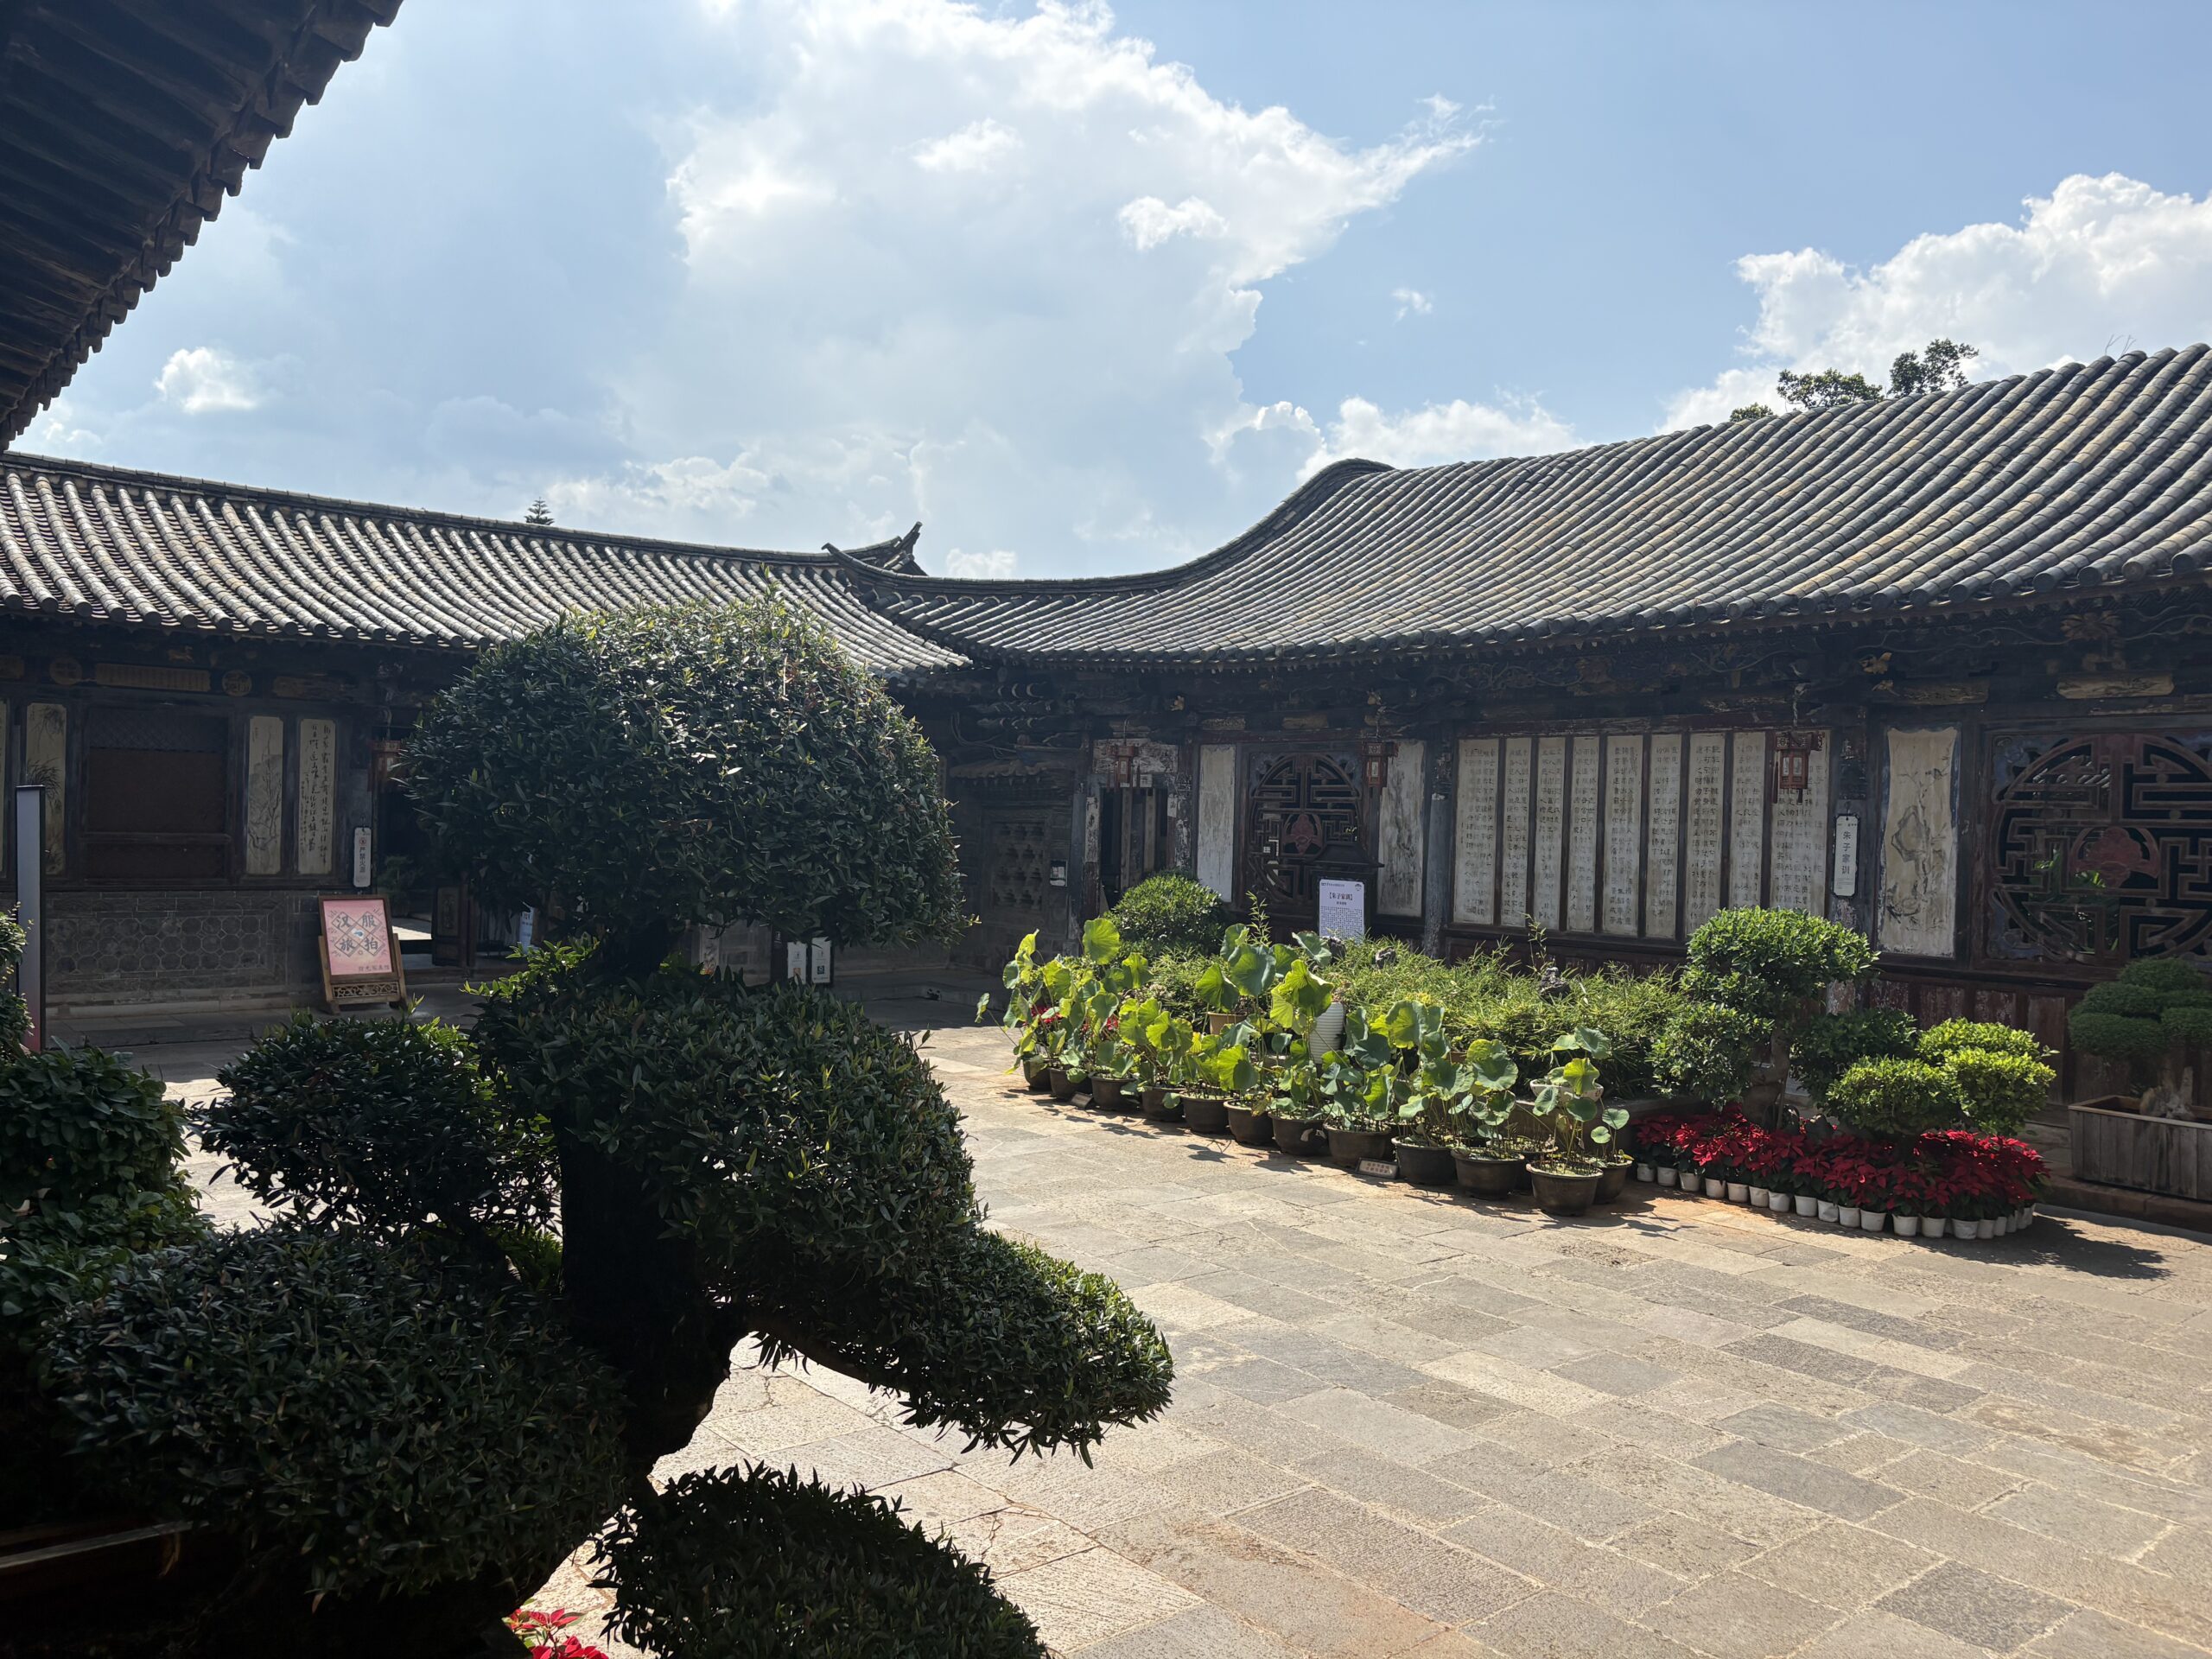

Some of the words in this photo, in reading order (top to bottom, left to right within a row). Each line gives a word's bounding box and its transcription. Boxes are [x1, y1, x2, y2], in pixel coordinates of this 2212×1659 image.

[1841, 831, 1852, 874] 朱子家训
[336, 914, 378, 929] 汉服
[340, 937, 378, 951] 旅拍
